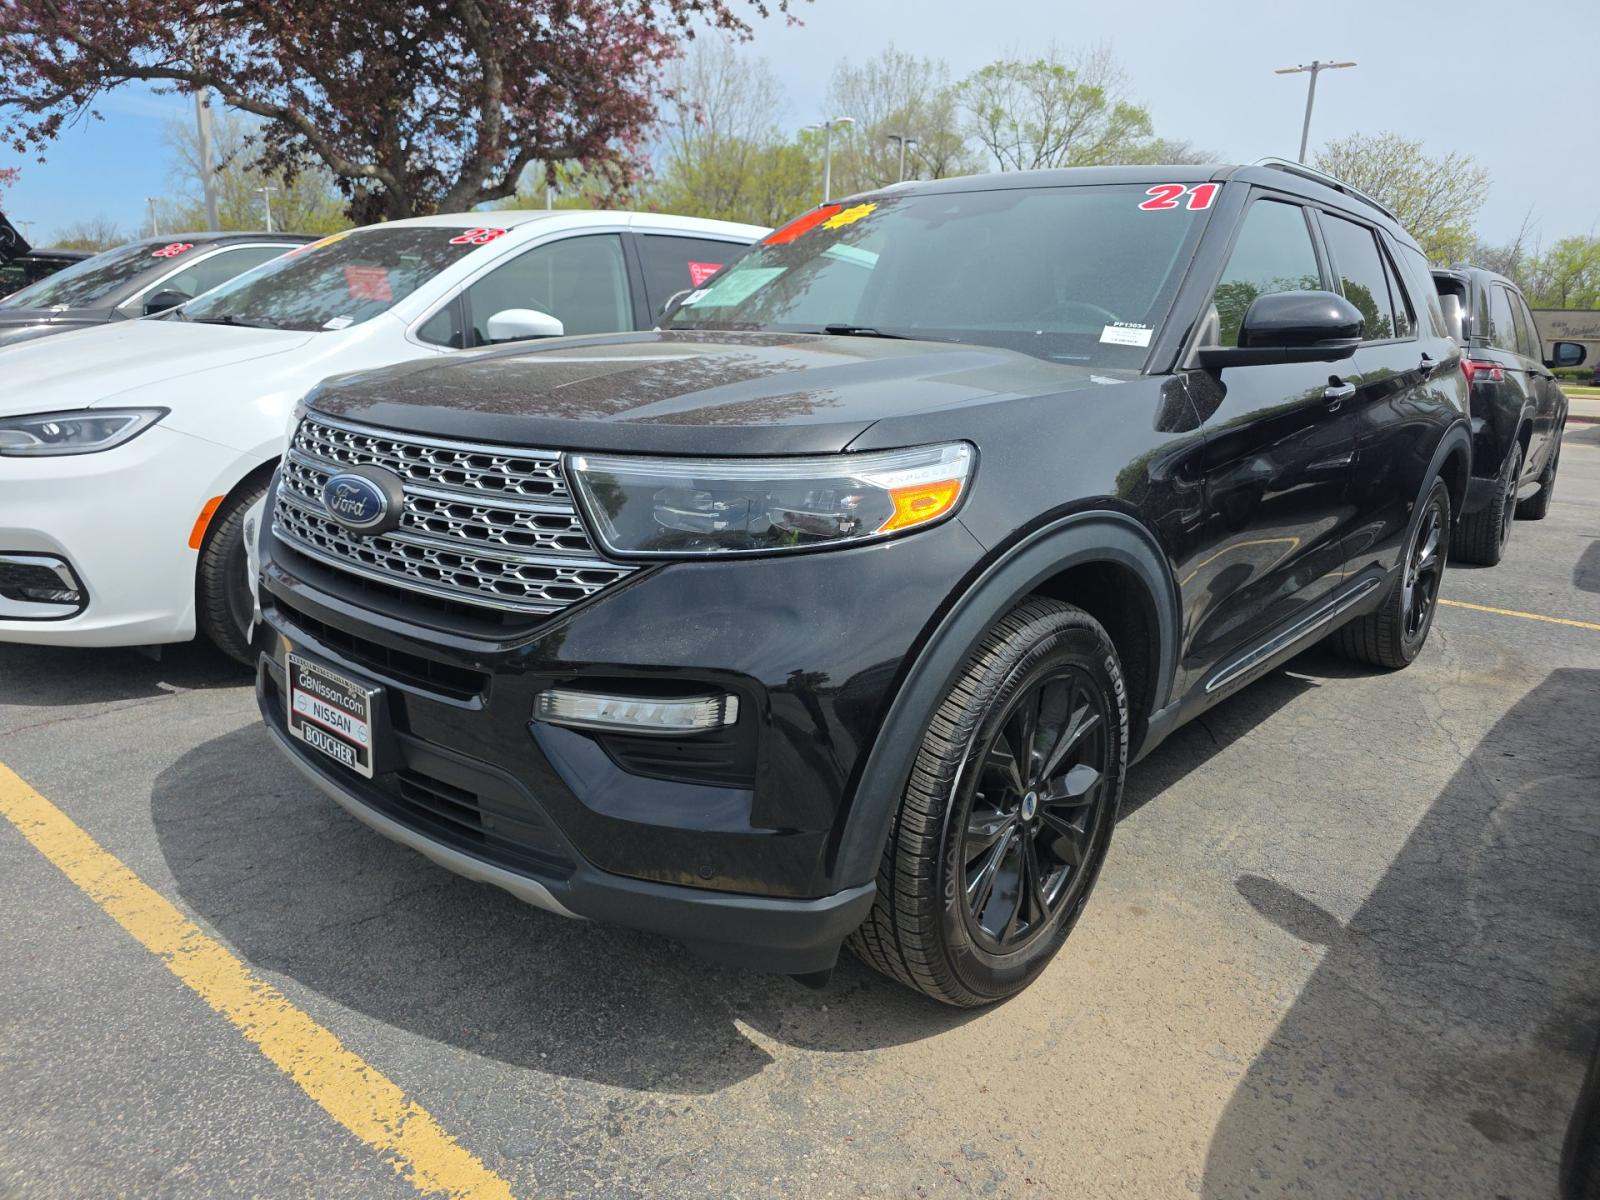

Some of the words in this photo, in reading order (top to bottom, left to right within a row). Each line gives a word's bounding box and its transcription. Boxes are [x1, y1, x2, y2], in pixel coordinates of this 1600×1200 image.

[1138, 183, 1220, 211] 21
[331, 483, 368, 516] Ford
[299, 673, 364, 716] GBNissan.com
[313, 702, 351, 735] NISSAN
[306, 727, 353, 764] BOUCHER
